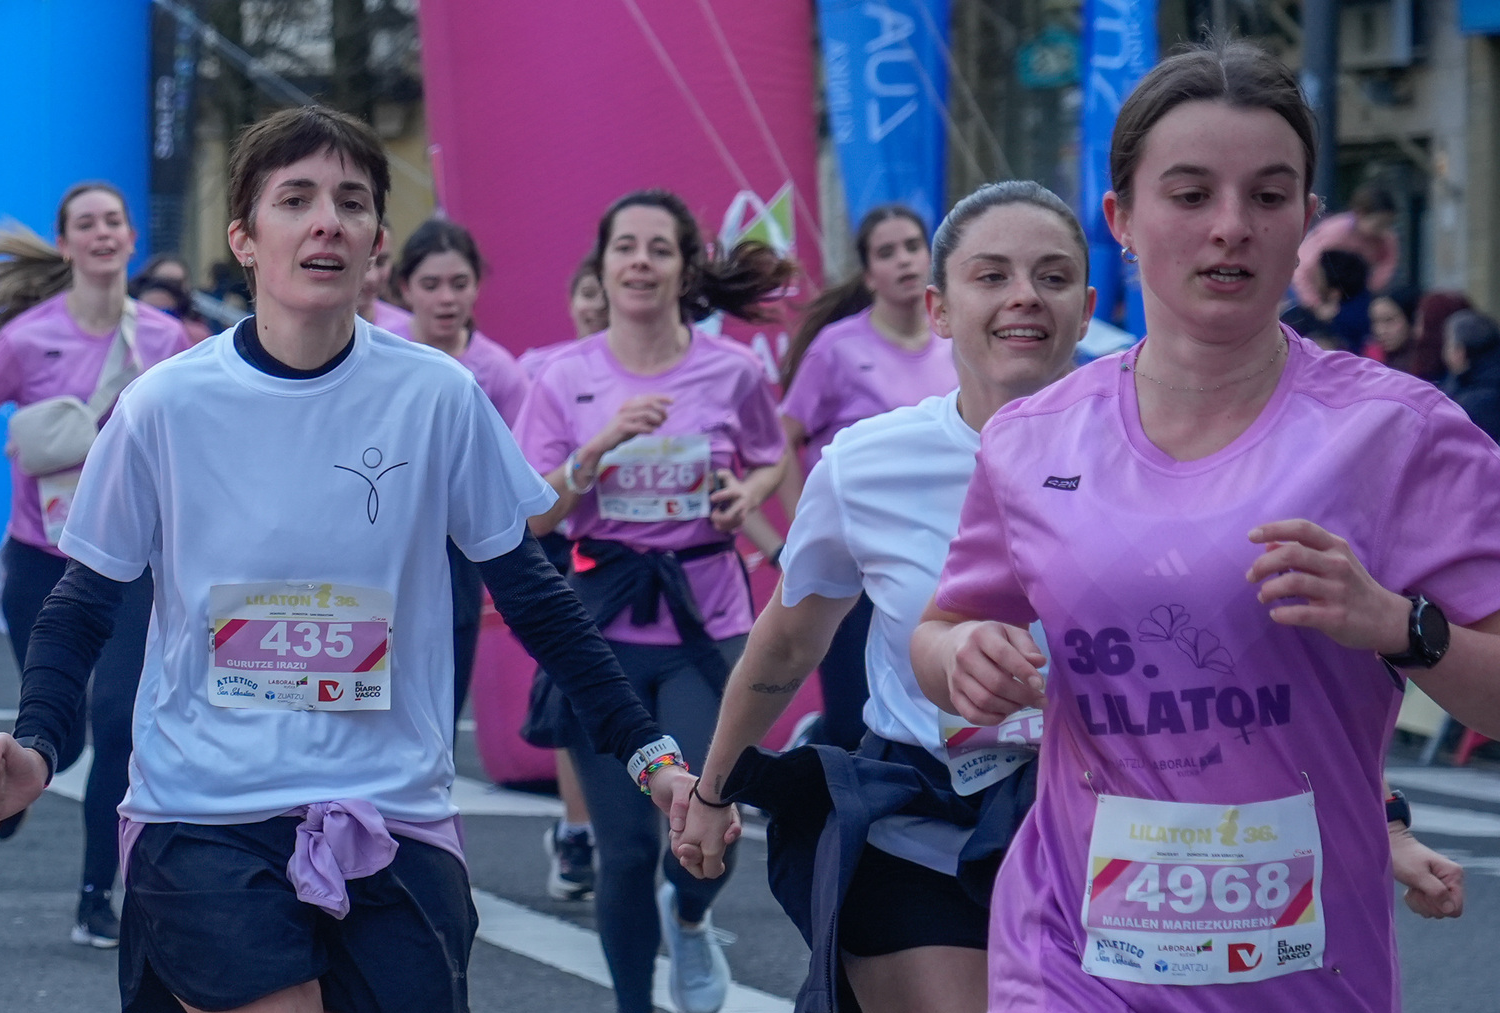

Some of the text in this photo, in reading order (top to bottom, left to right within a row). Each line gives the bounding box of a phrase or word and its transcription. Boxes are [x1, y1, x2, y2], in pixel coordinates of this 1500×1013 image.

[617, 464, 695, 489] 6126
[245, 594, 311, 608] LILATON
[259, 621, 354, 659] 435
[1064, 627, 1159, 679] 36.
[226, 659, 307, 669] GURUTZE IRAZU
[217, 676, 258, 690] ATLETICO
[277, 692, 305, 700] ZUATZU
[1076, 684, 1291, 738] LILATON
[957, 754, 997, 777] ATLETICO
[1129, 823, 1278, 845] LILATON 36.
[1125, 862, 1290, 914] 4968
[1102, 915, 1277, 932] MAIALEN MARIEZKURRENA
[1096, 939, 1144, 959] ATLETICO
[1157, 944, 1196, 952] LABORAL
[1277, 943, 1312, 955] DIARIO
[1278, 950, 1310, 962] VASCO
[1171, 963, 1209, 972] ZUATZU
